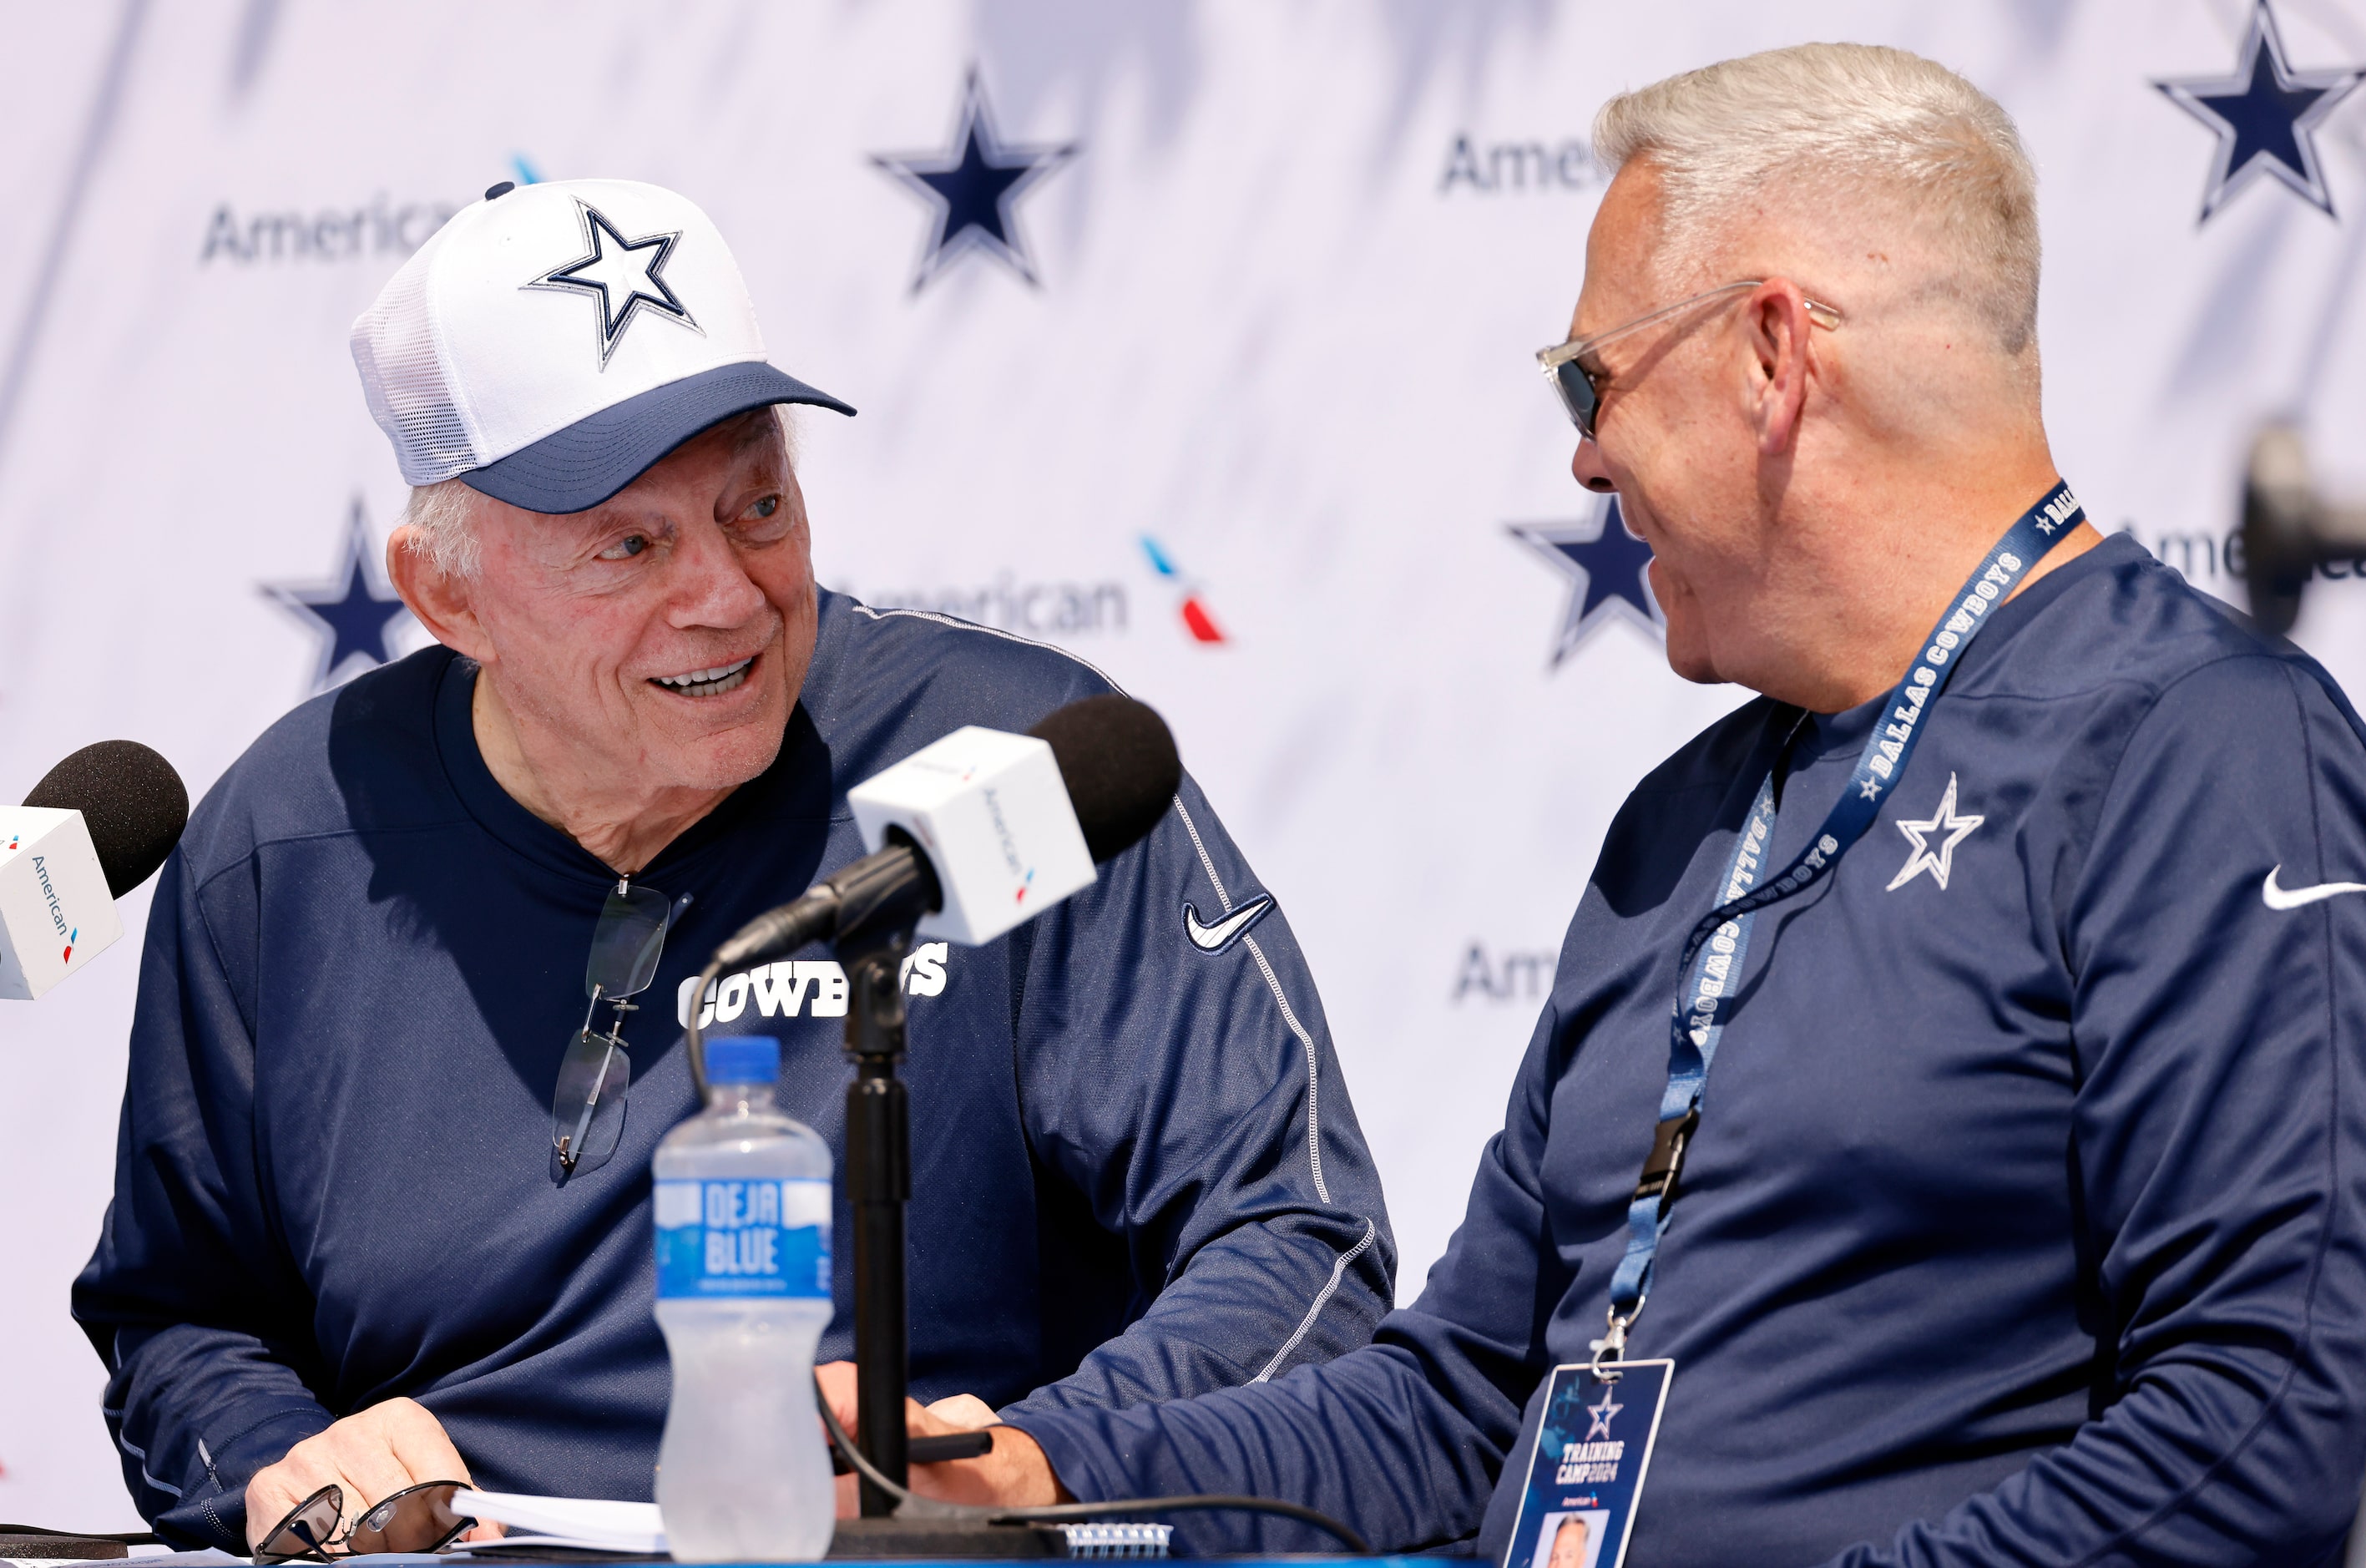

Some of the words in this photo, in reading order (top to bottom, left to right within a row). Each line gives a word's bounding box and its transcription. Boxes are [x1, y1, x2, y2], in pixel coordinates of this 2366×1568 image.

[1868, 665, 1938, 780] DALLAS
[1925, 552, 2022, 665] COWBOYS
[32, 854, 68, 937] American
[677, 942, 948, 1031] COWBS
[705, 1182, 780, 1230] DEJA
[704, 1227, 780, 1275] BLUE
[1563, 1441, 1625, 1464] TRAINING
